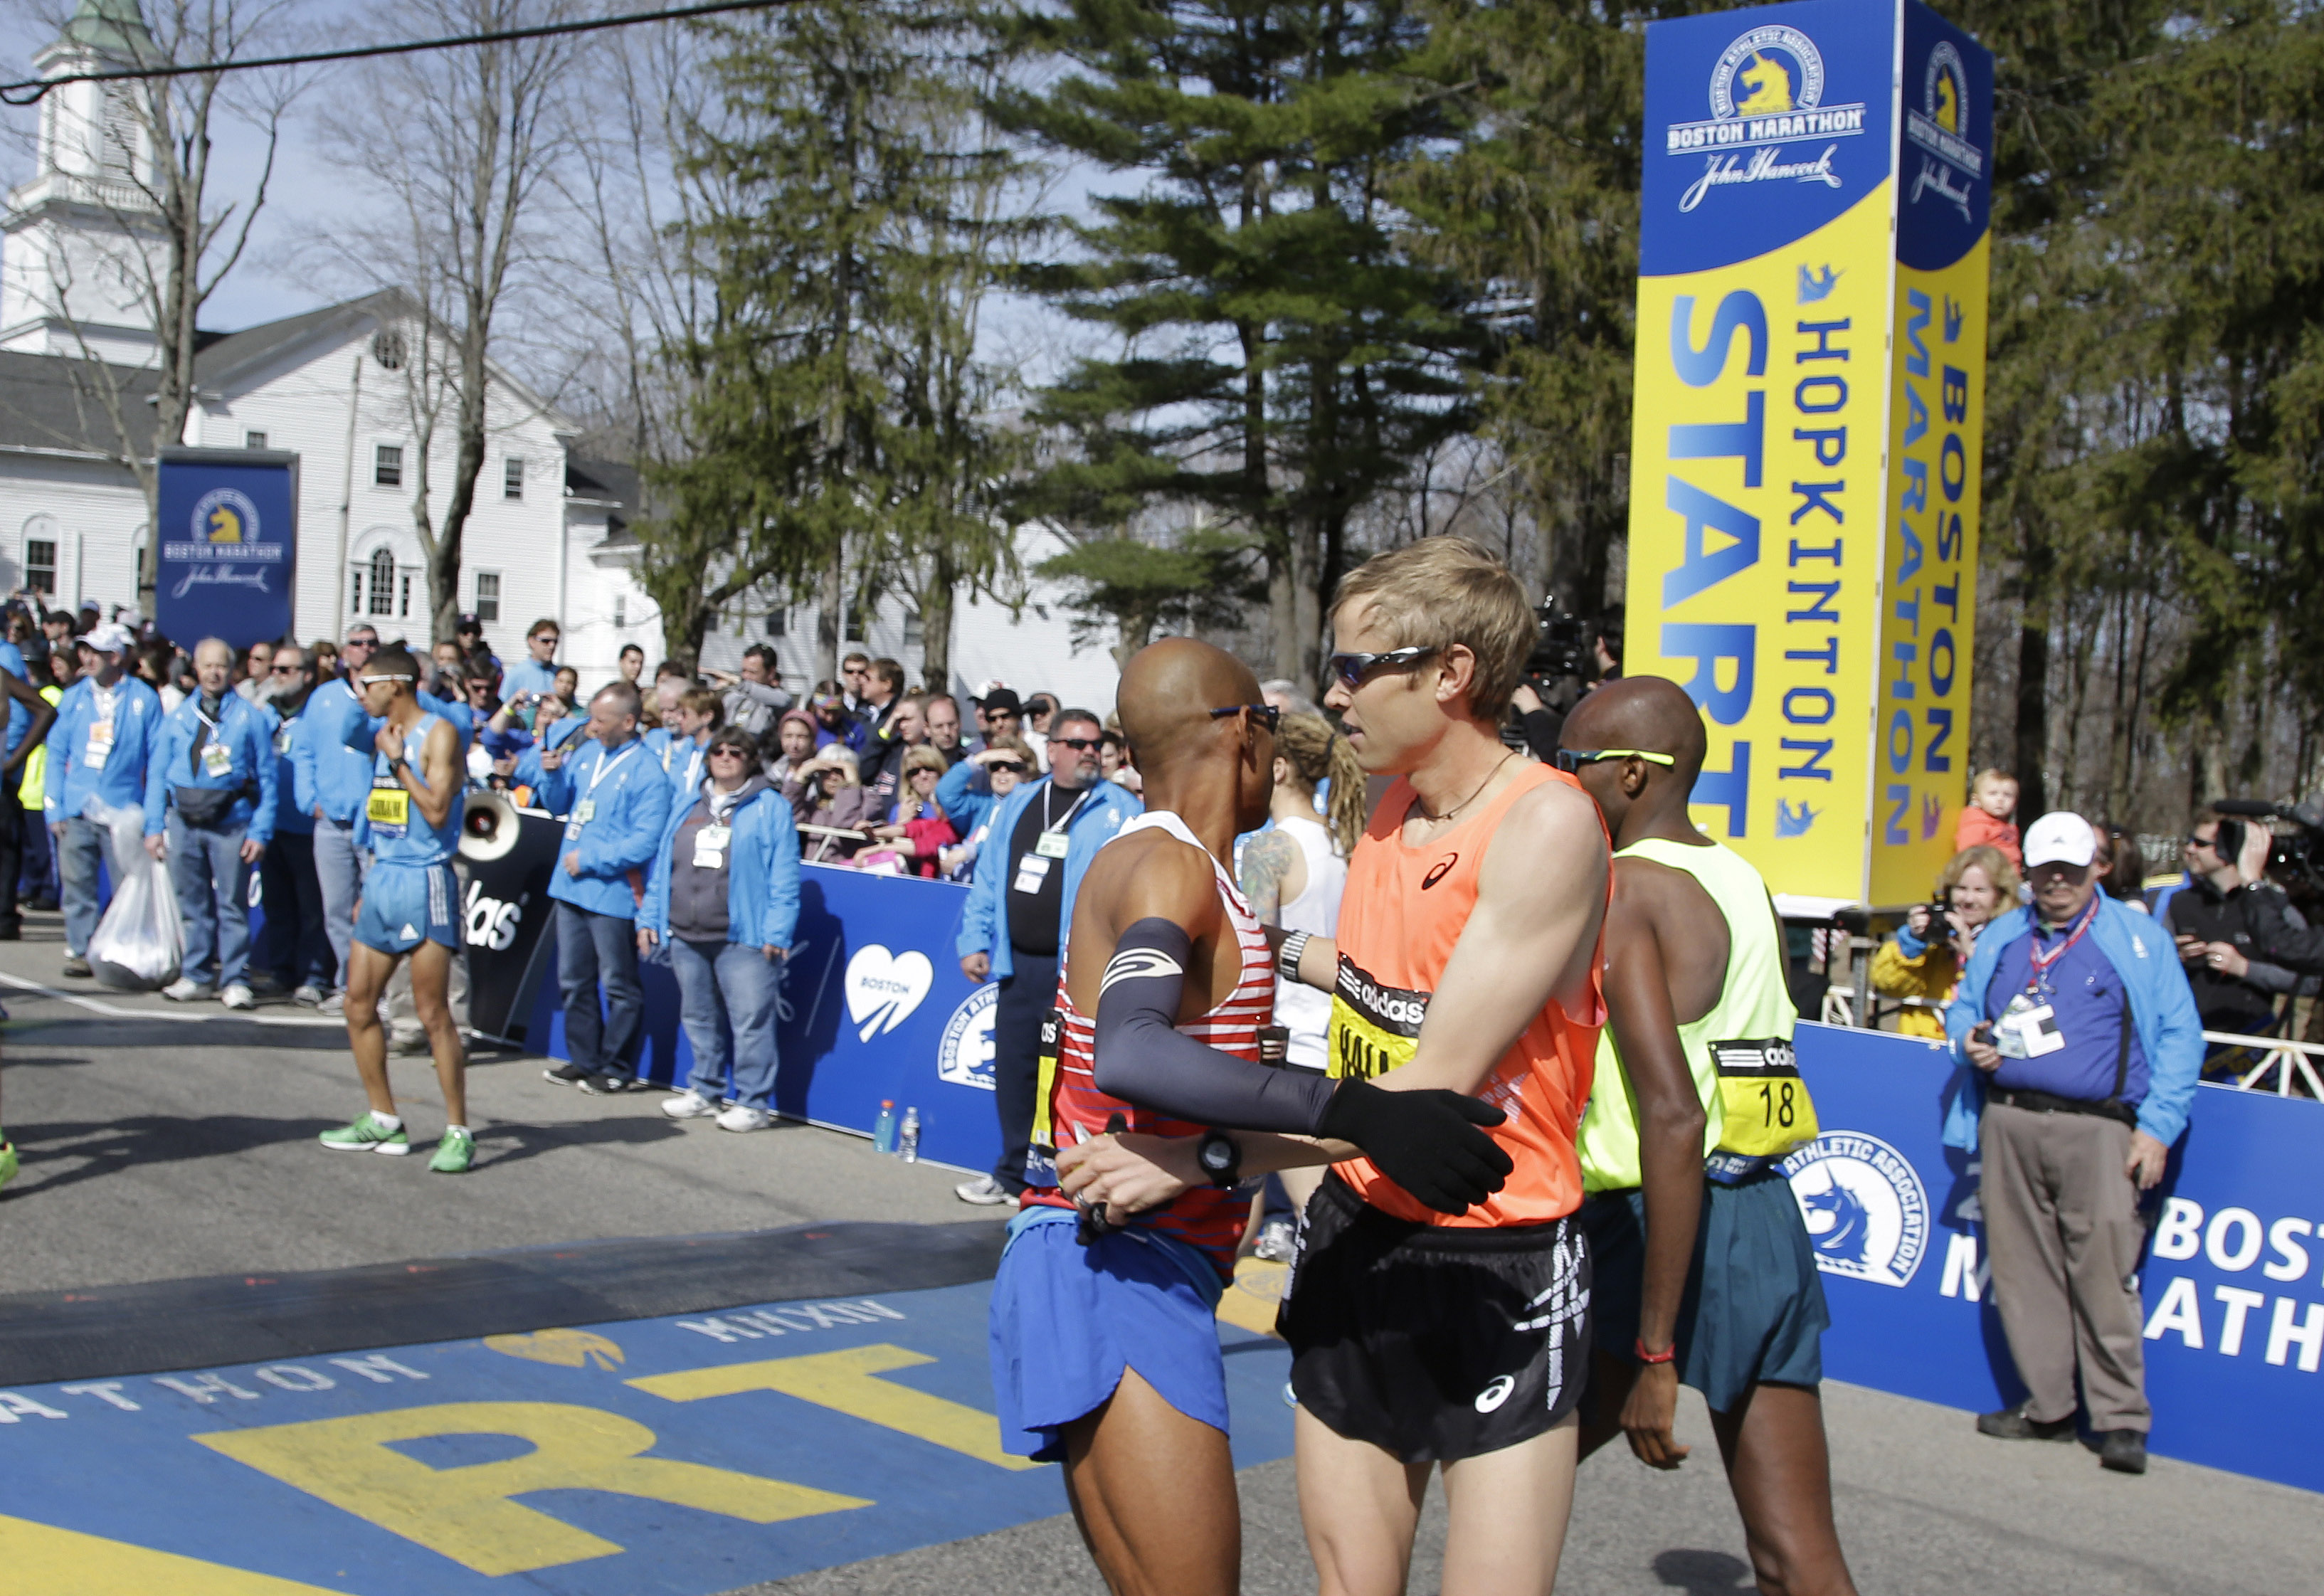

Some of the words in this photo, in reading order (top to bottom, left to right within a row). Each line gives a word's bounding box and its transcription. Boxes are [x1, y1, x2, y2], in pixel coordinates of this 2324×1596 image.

[1667, 122, 1744, 149] BOSTON
[1748, 110, 1861, 140] MARATHON
[1678, 152, 1745, 213] John
[1743, 143, 1843, 189] Hancock
[1659, 288, 1768, 837] START
[1778, 317, 1852, 781] HOPKINTON
[1884, 287, 1933, 846] MARATHON
[1924, 364, 1968, 773] BOSTON
[861, 976, 910, 995] BOSTON
[943, 1010, 971, 1071] BOSTON
[1760, 1082, 1794, 1128] 18
[1782, 1137, 1875, 1175] ATHLETIC
[1869, 1149, 1923, 1274] ASSOCIATION
[2153, 1196, 2324, 1289] BOS
[675, 1299, 906, 1343] MMXIV
